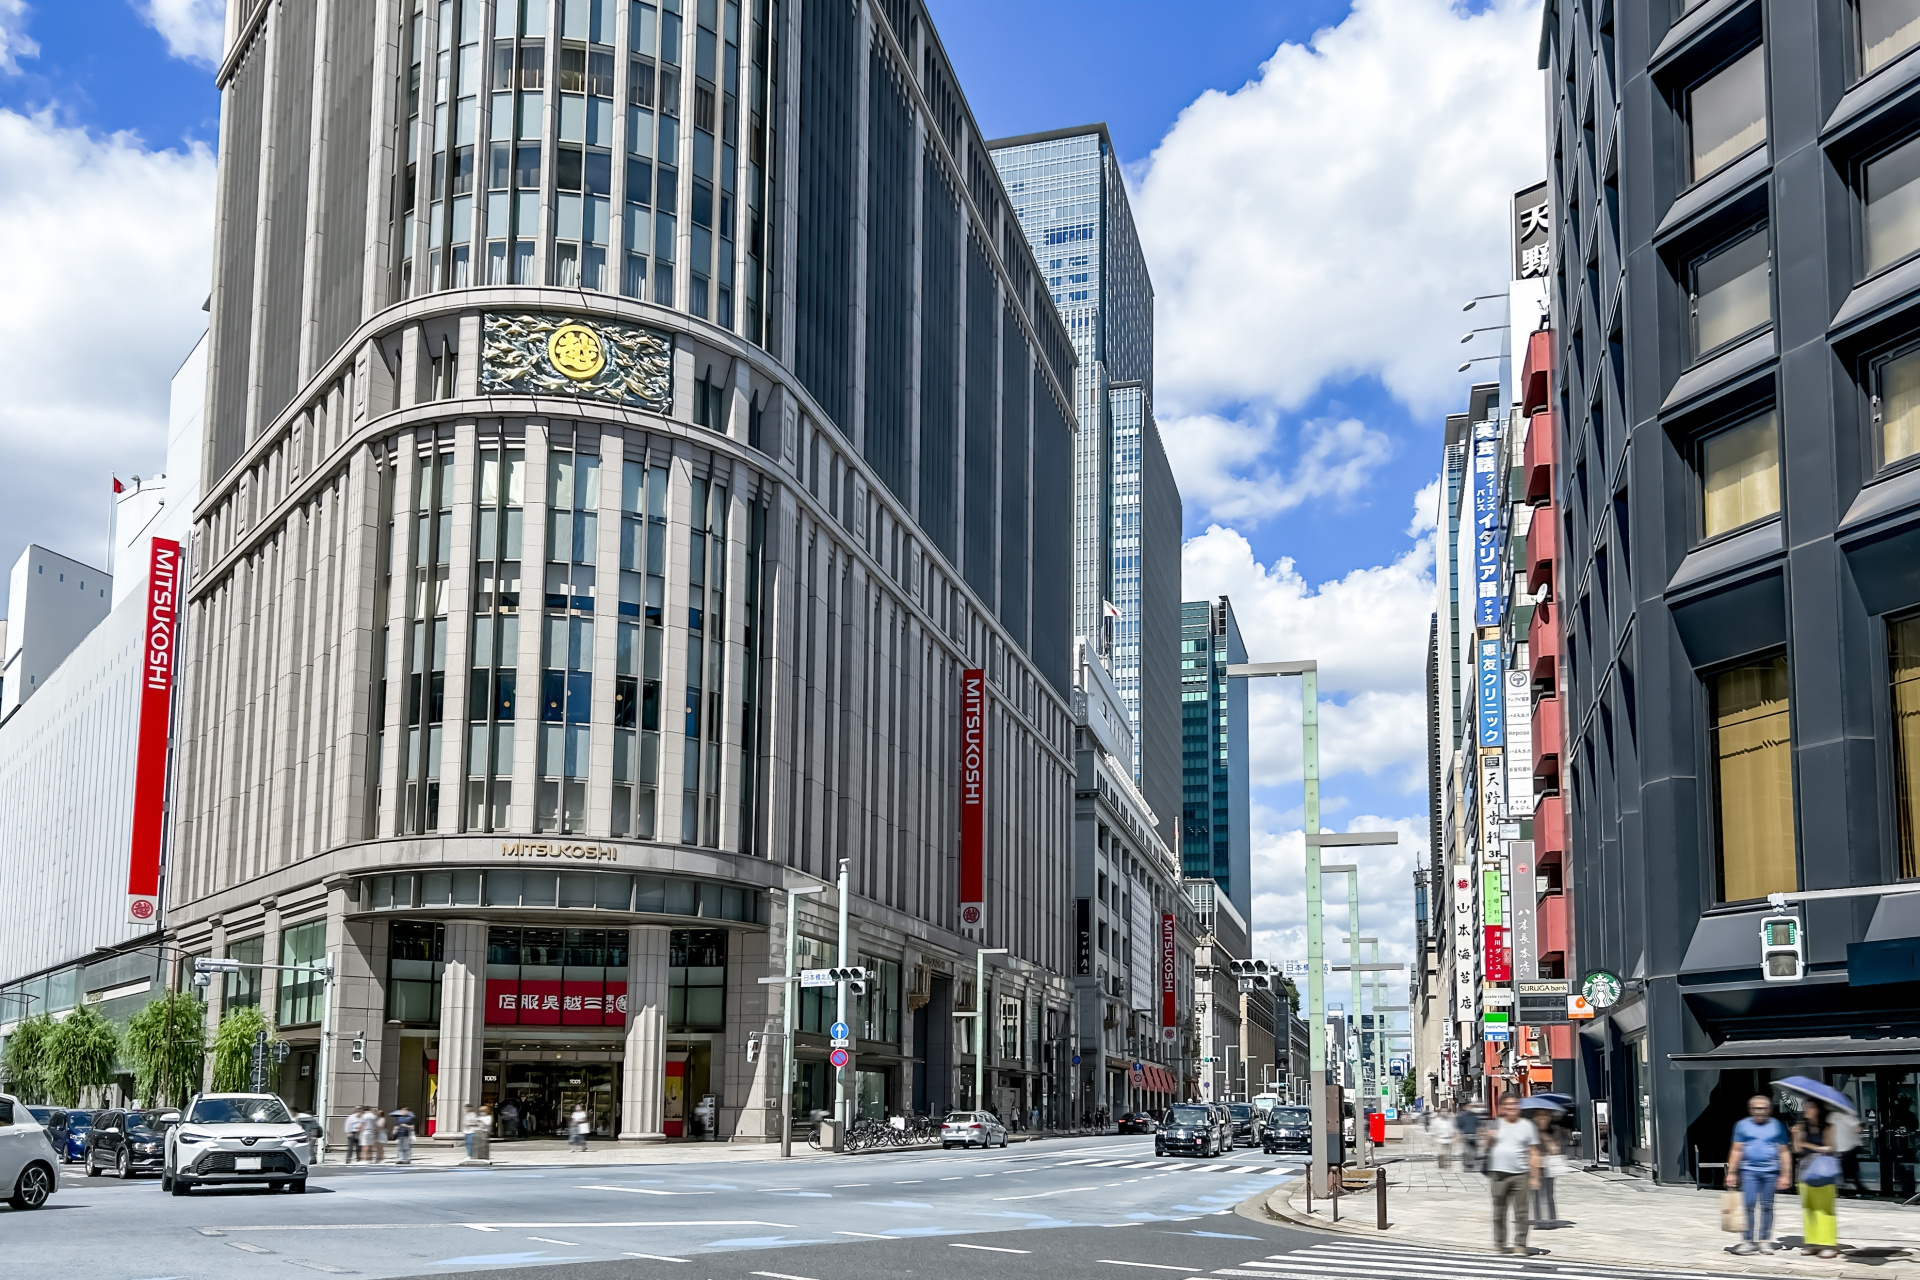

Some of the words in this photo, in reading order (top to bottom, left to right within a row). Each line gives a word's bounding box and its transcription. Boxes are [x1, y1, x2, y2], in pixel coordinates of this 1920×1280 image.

[1475, 421, 1495, 473] 英会話
[1486, 473, 1496, 510] クイーンズ
[1478, 512, 1497, 598] イタリア語
[148, 548, 175, 690] MITSUKOSHI
[1484, 599, 1494, 622] チャオ
[1482, 643, 1499, 743] 恵友クリニック
[965, 678, 981, 805] MITSUKOSHI
[1485, 772, 1500, 844] 天野歯科
[501, 843, 617, 861] MITSUKOSHI
[1164, 920, 1174, 992] MITSUKOSHI
[1456, 902, 1472, 1009] 山本海苔店
